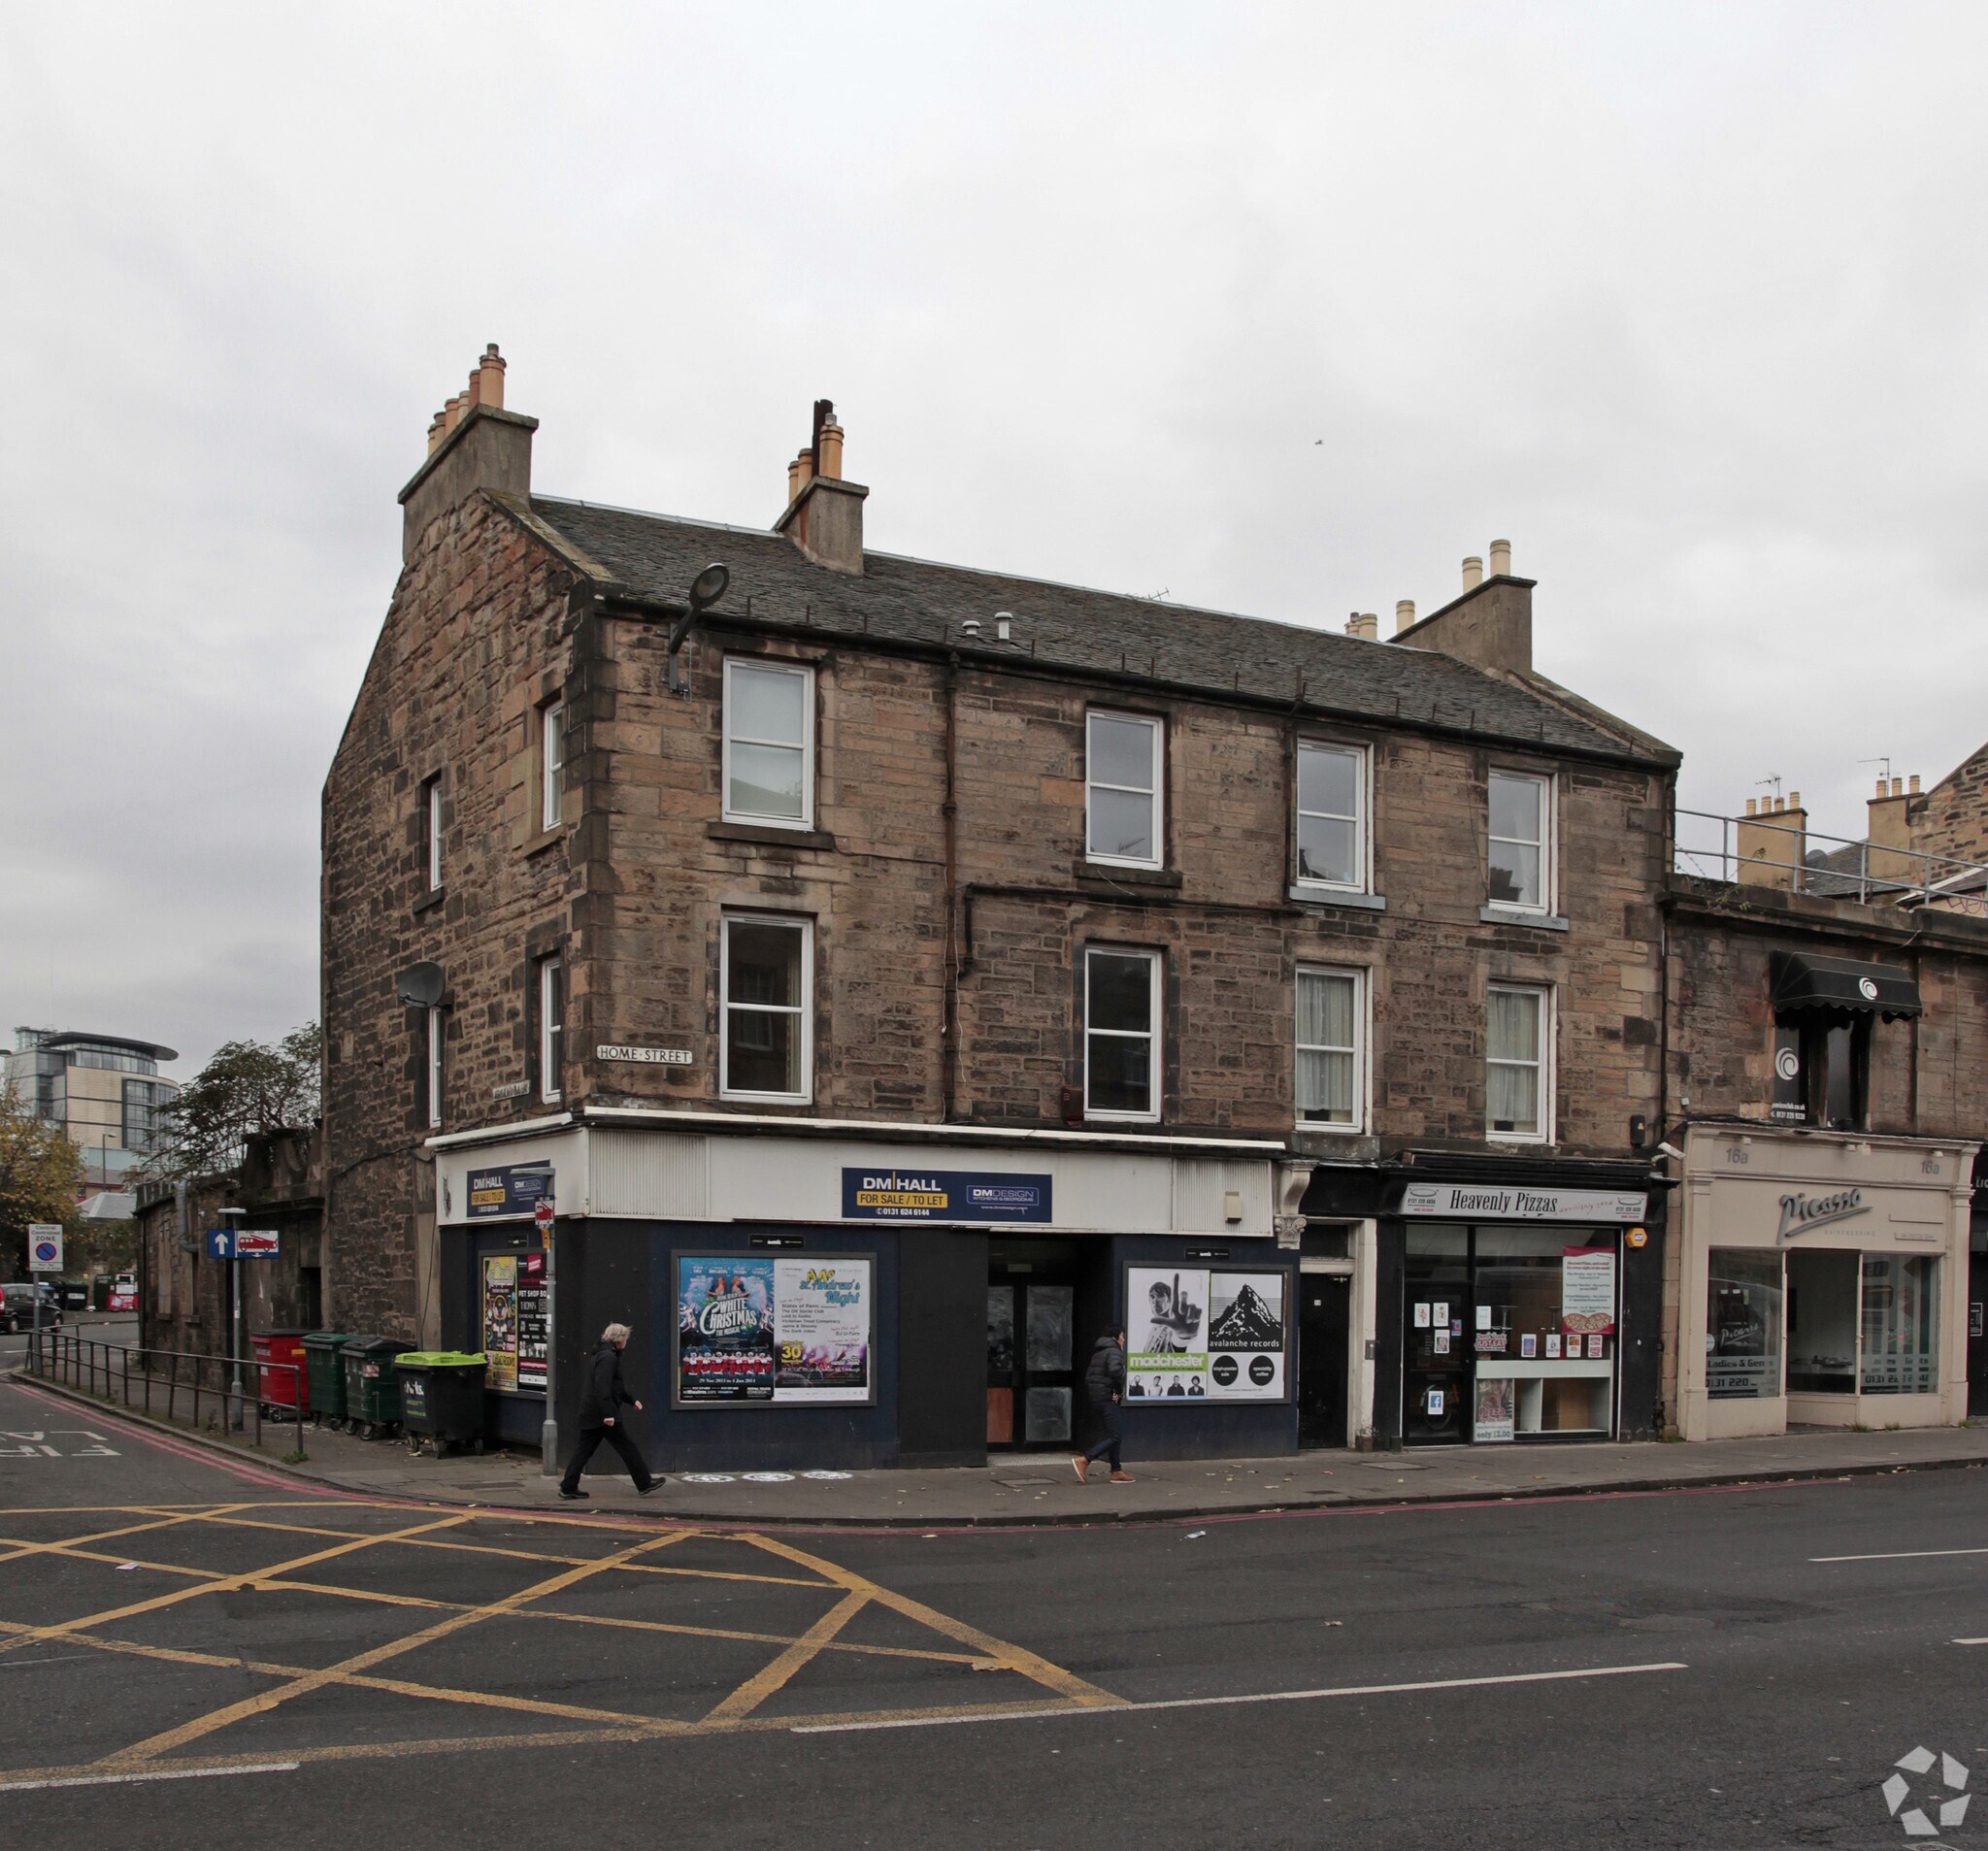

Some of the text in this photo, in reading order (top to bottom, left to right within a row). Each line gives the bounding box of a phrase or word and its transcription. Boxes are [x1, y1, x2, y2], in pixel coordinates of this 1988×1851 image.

[600, 1046, 690, 1064] HOME STREET
[1726, 1147, 1748, 1165] 16a
[1920, 1159, 1939, 1174] 16a
[860, 1193, 878, 1204] FOR
[880, 1194, 904, 1205] SALE
[913, 1195, 925, 1206] TO
[927, 1196, 943, 1206] LET
[1449, 1189, 1558, 1213] Heavenly Pizzas
[1776, 1187, 1863, 1245] Picasso
[719, 1298, 747, 1313] WHITE
[825, 1290, 860, 1307] Night
[700, 1302, 757, 1335] CHRISTMAS
[1209, 1339, 1279, 1347] avalanche records
[781, 1345, 802, 1359] 30
[1130, 1354, 1204, 1367] madchester
[1708, 1359, 1737, 1368] Ladies
[1729, 1377, 1749, 1387] 220
[1480, 1406, 1507, 1416] Pizza
